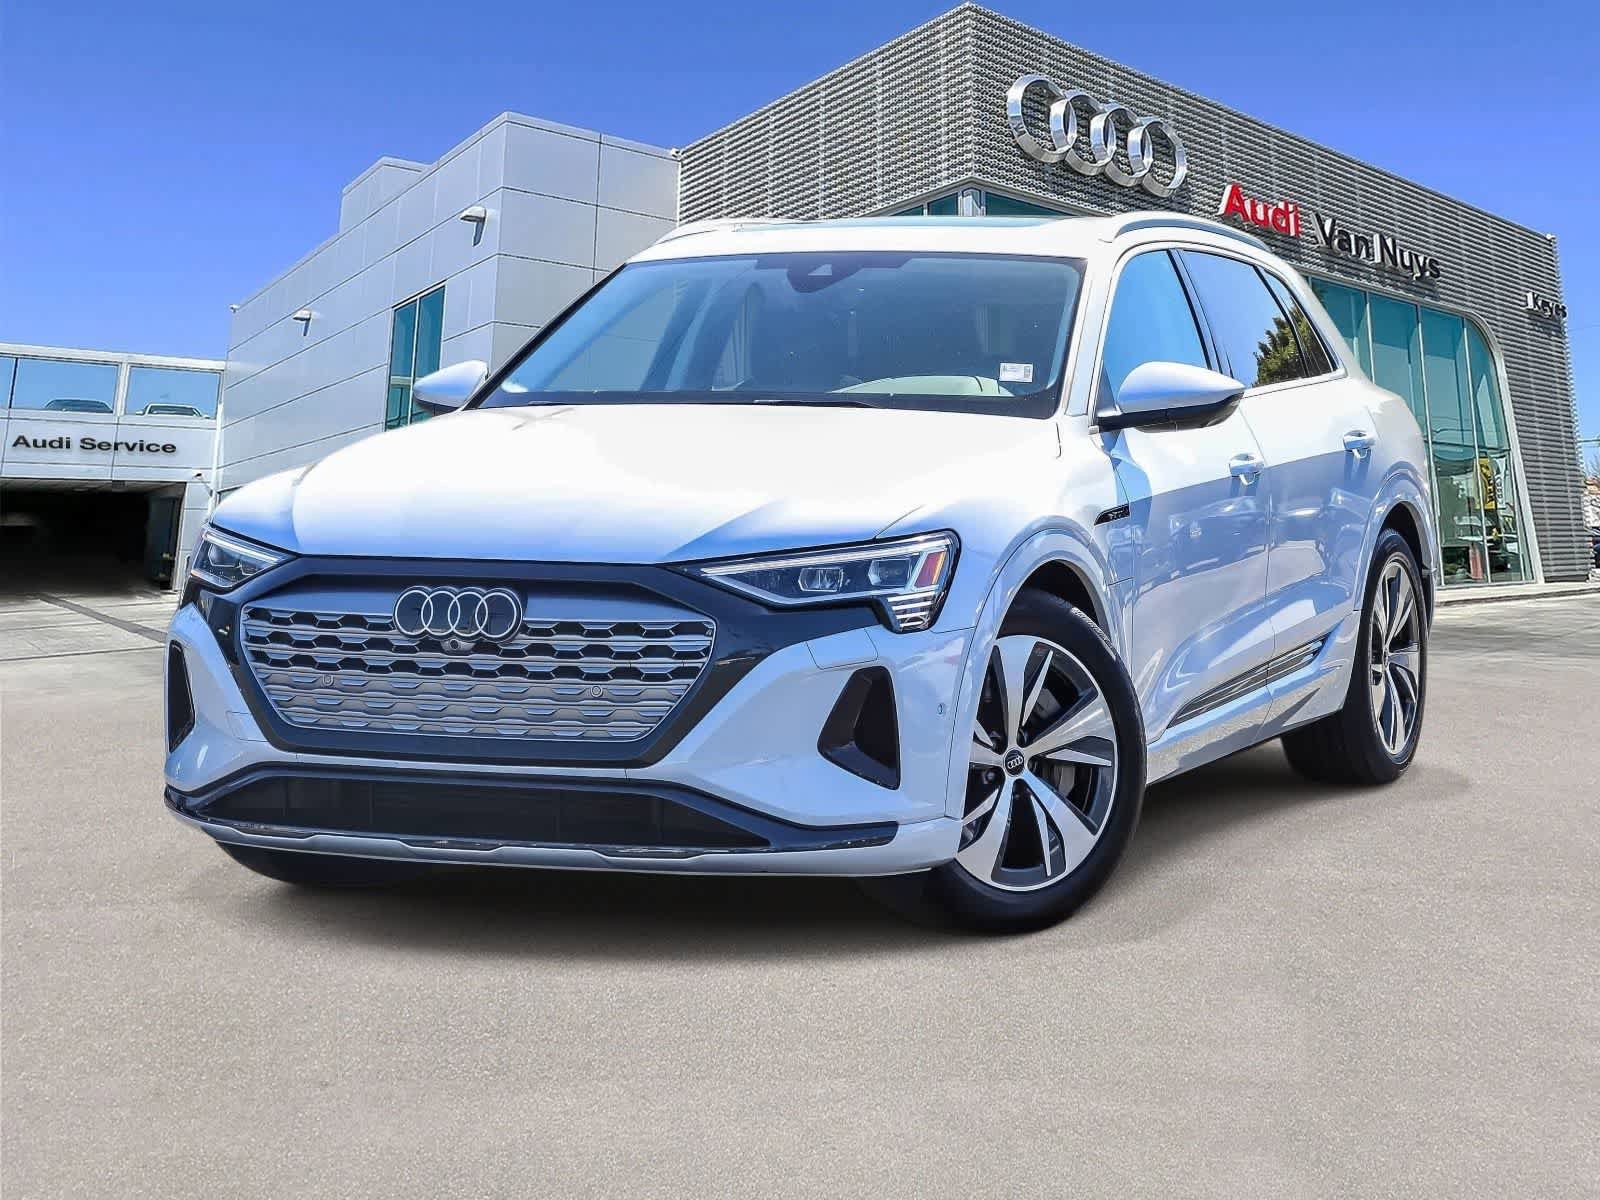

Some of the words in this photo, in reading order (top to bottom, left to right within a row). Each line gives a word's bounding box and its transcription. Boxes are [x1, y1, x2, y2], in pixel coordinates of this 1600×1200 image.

[1218, 182, 1301, 238] Audi
[1312, 212, 1370, 259] Van
[1373, 232, 1441, 281] Nuys
[12, 435, 71, 449] Audi
[79, 437, 177, 454] Service
